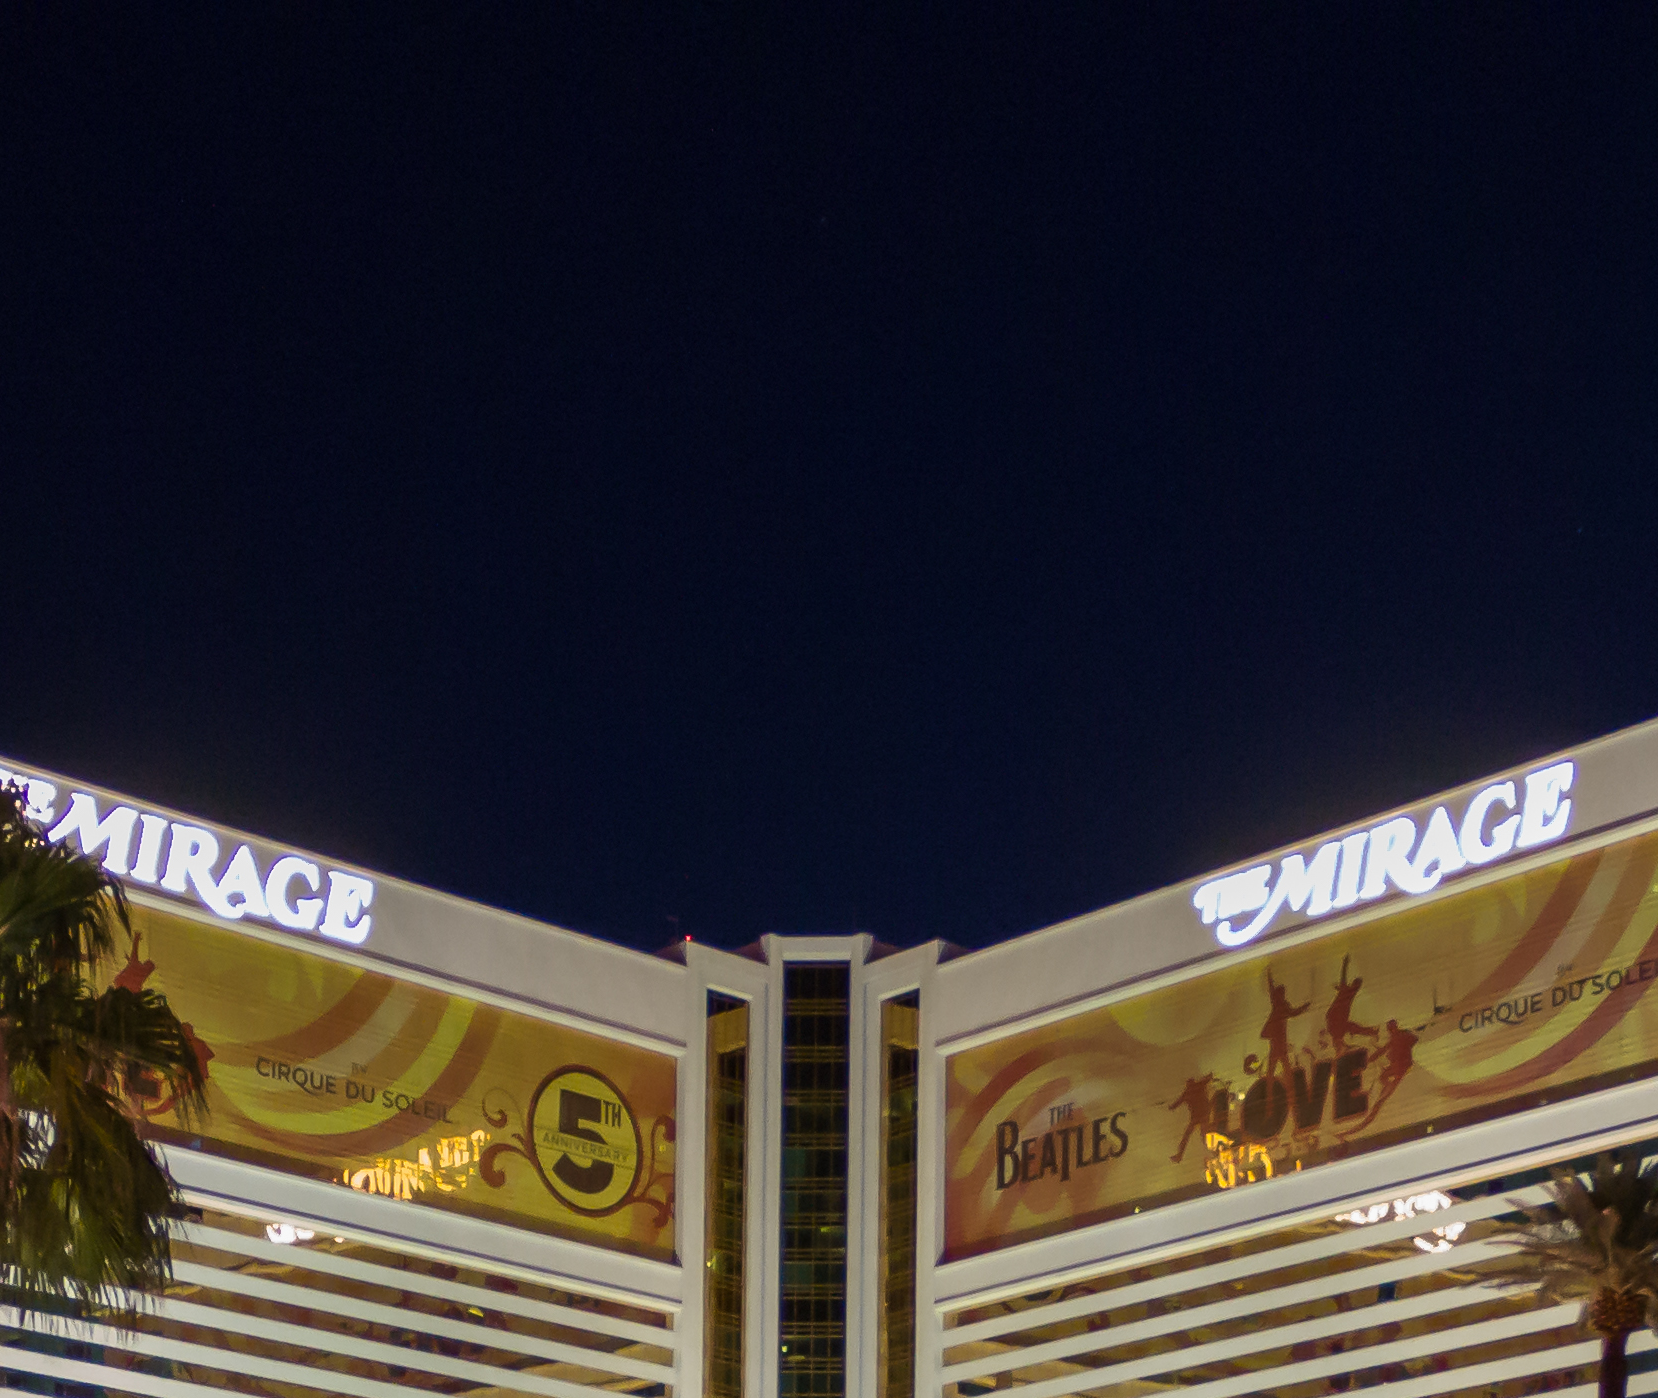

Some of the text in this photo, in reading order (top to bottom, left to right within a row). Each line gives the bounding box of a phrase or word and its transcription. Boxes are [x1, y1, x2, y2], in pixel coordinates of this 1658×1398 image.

[48, 792, 374, 944] MIRAGE
[1217, 762, 1574, 947] MIRAGE
[1459, 993, 1542, 1033] CIRQUE
[1552, 977, 1585, 1007] DU
[255, 1056, 452, 1124] CIRQUE DU SOLEIL
[1049, 1102, 1075, 1126] THE
[1208, 1047, 1369, 1148] LOVE
[543, 1131, 629, 1163] ANNIVERSARY
[552, 1089, 622, 1194] 5TH
[995, 1111, 1129, 1191] BEATLES
